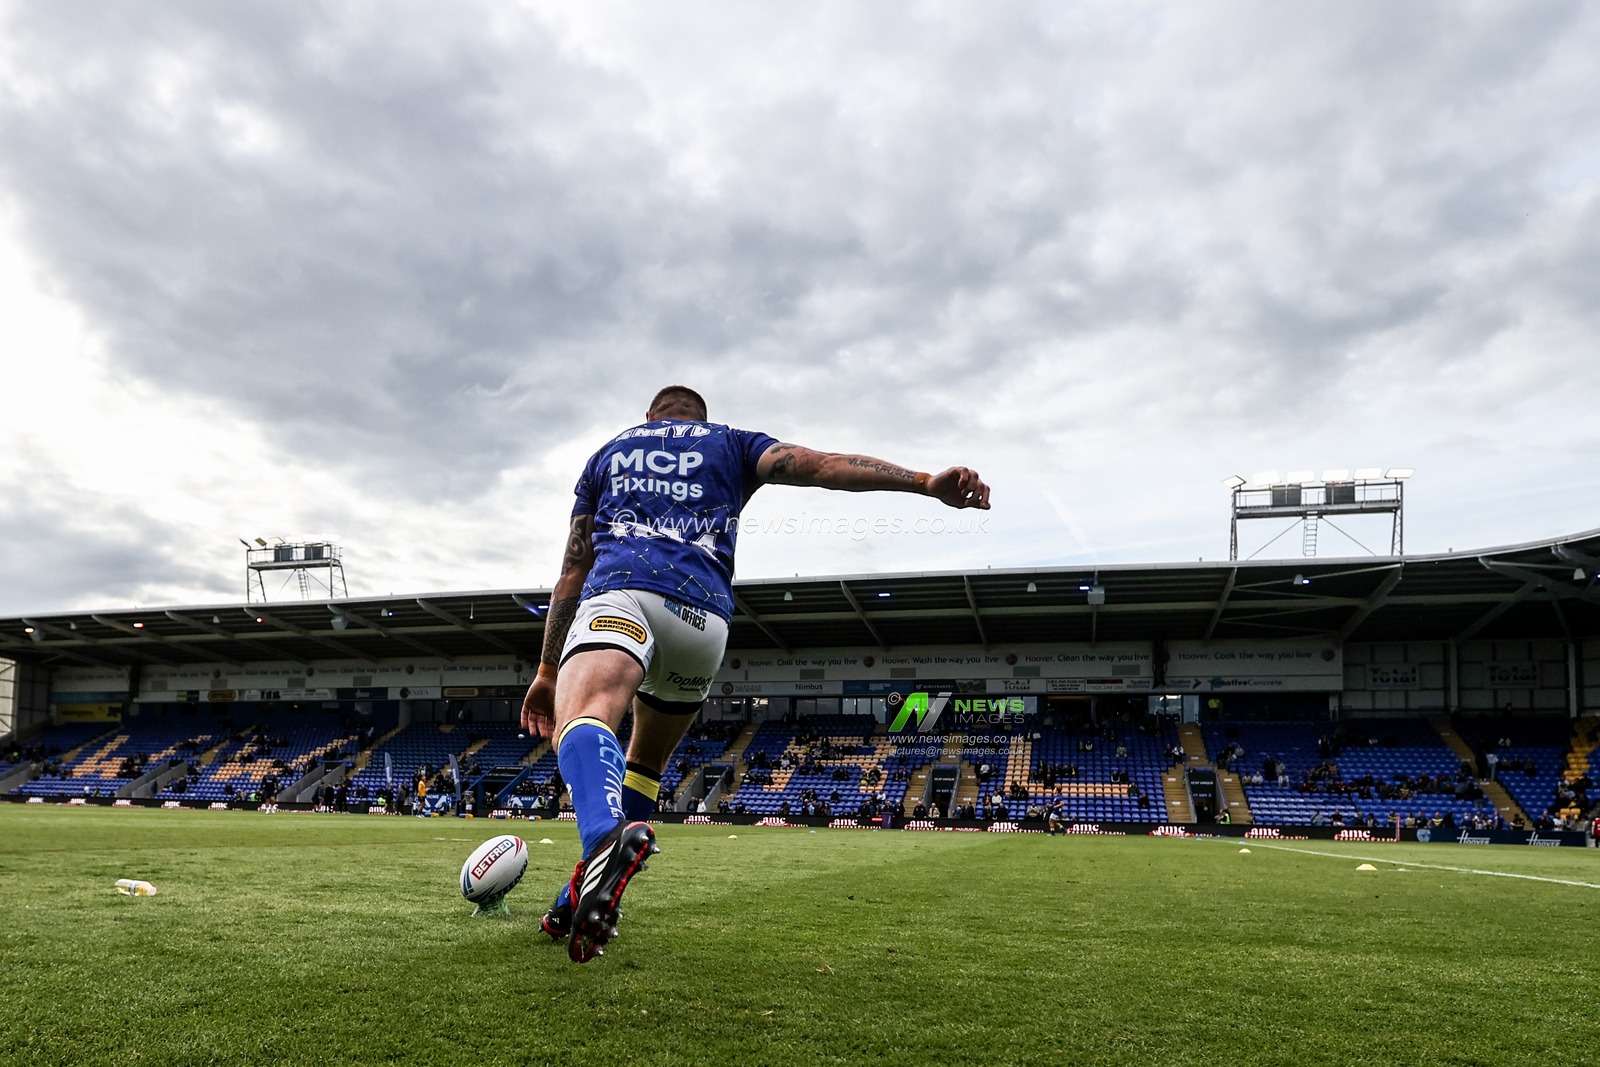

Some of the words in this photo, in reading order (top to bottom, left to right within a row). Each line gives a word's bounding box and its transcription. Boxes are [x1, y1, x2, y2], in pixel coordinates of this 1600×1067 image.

[611, 449, 704, 476] MCP
[611, 473, 703, 501] Fixings
[682, 608, 707, 631] OFFICES
[595, 624, 642, 639] FABRICATIONS
[596, 619, 643, 635] WARRINGTON
[912, 655, 932, 664] Wash
[935, 655, 948, 664] the
[948, 657, 964, 666] way
[966, 657, 981, 666] you
[985, 655, 999, 663] live
[1058, 654, 1080, 662] Clean
[1082, 653, 1096, 662] the
[1098, 655, 1115, 663] way
[1117, 655, 1132, 663] you
[1134, 653, 1149, 661] live
[1215, 652, 1236, 660] Cook
[1239, 651, 1254, 659] the
[1258, 653, 1275, 661] way
[1278, 652, 1294, 661] you
[1296, 651, 1312, 659] live
[777, 658, 794, 666] Chill
[795, 658, 808, 666] the
[811, 660, 826, 668] way
[828, 659, 842, 667] you
[1369, 666, 1417, 683] Total
[1487, 665, 1538, 681] Total
[795, 683, 823, 691] Nimbus
[688, 814, 711, 822] amc
[834, 818, 858, 826] amc
[909, 820, 935, 828] amc
[993, 821, 1019, 829] amc
[1072, 823, 1100, 831] amc
[1157, 825, 1185, 833] amc
[1250, 827, 1280, 836] amc
[1340, 829, 1371, 838] amc
[474, 841, 512, 878] BETFRED
